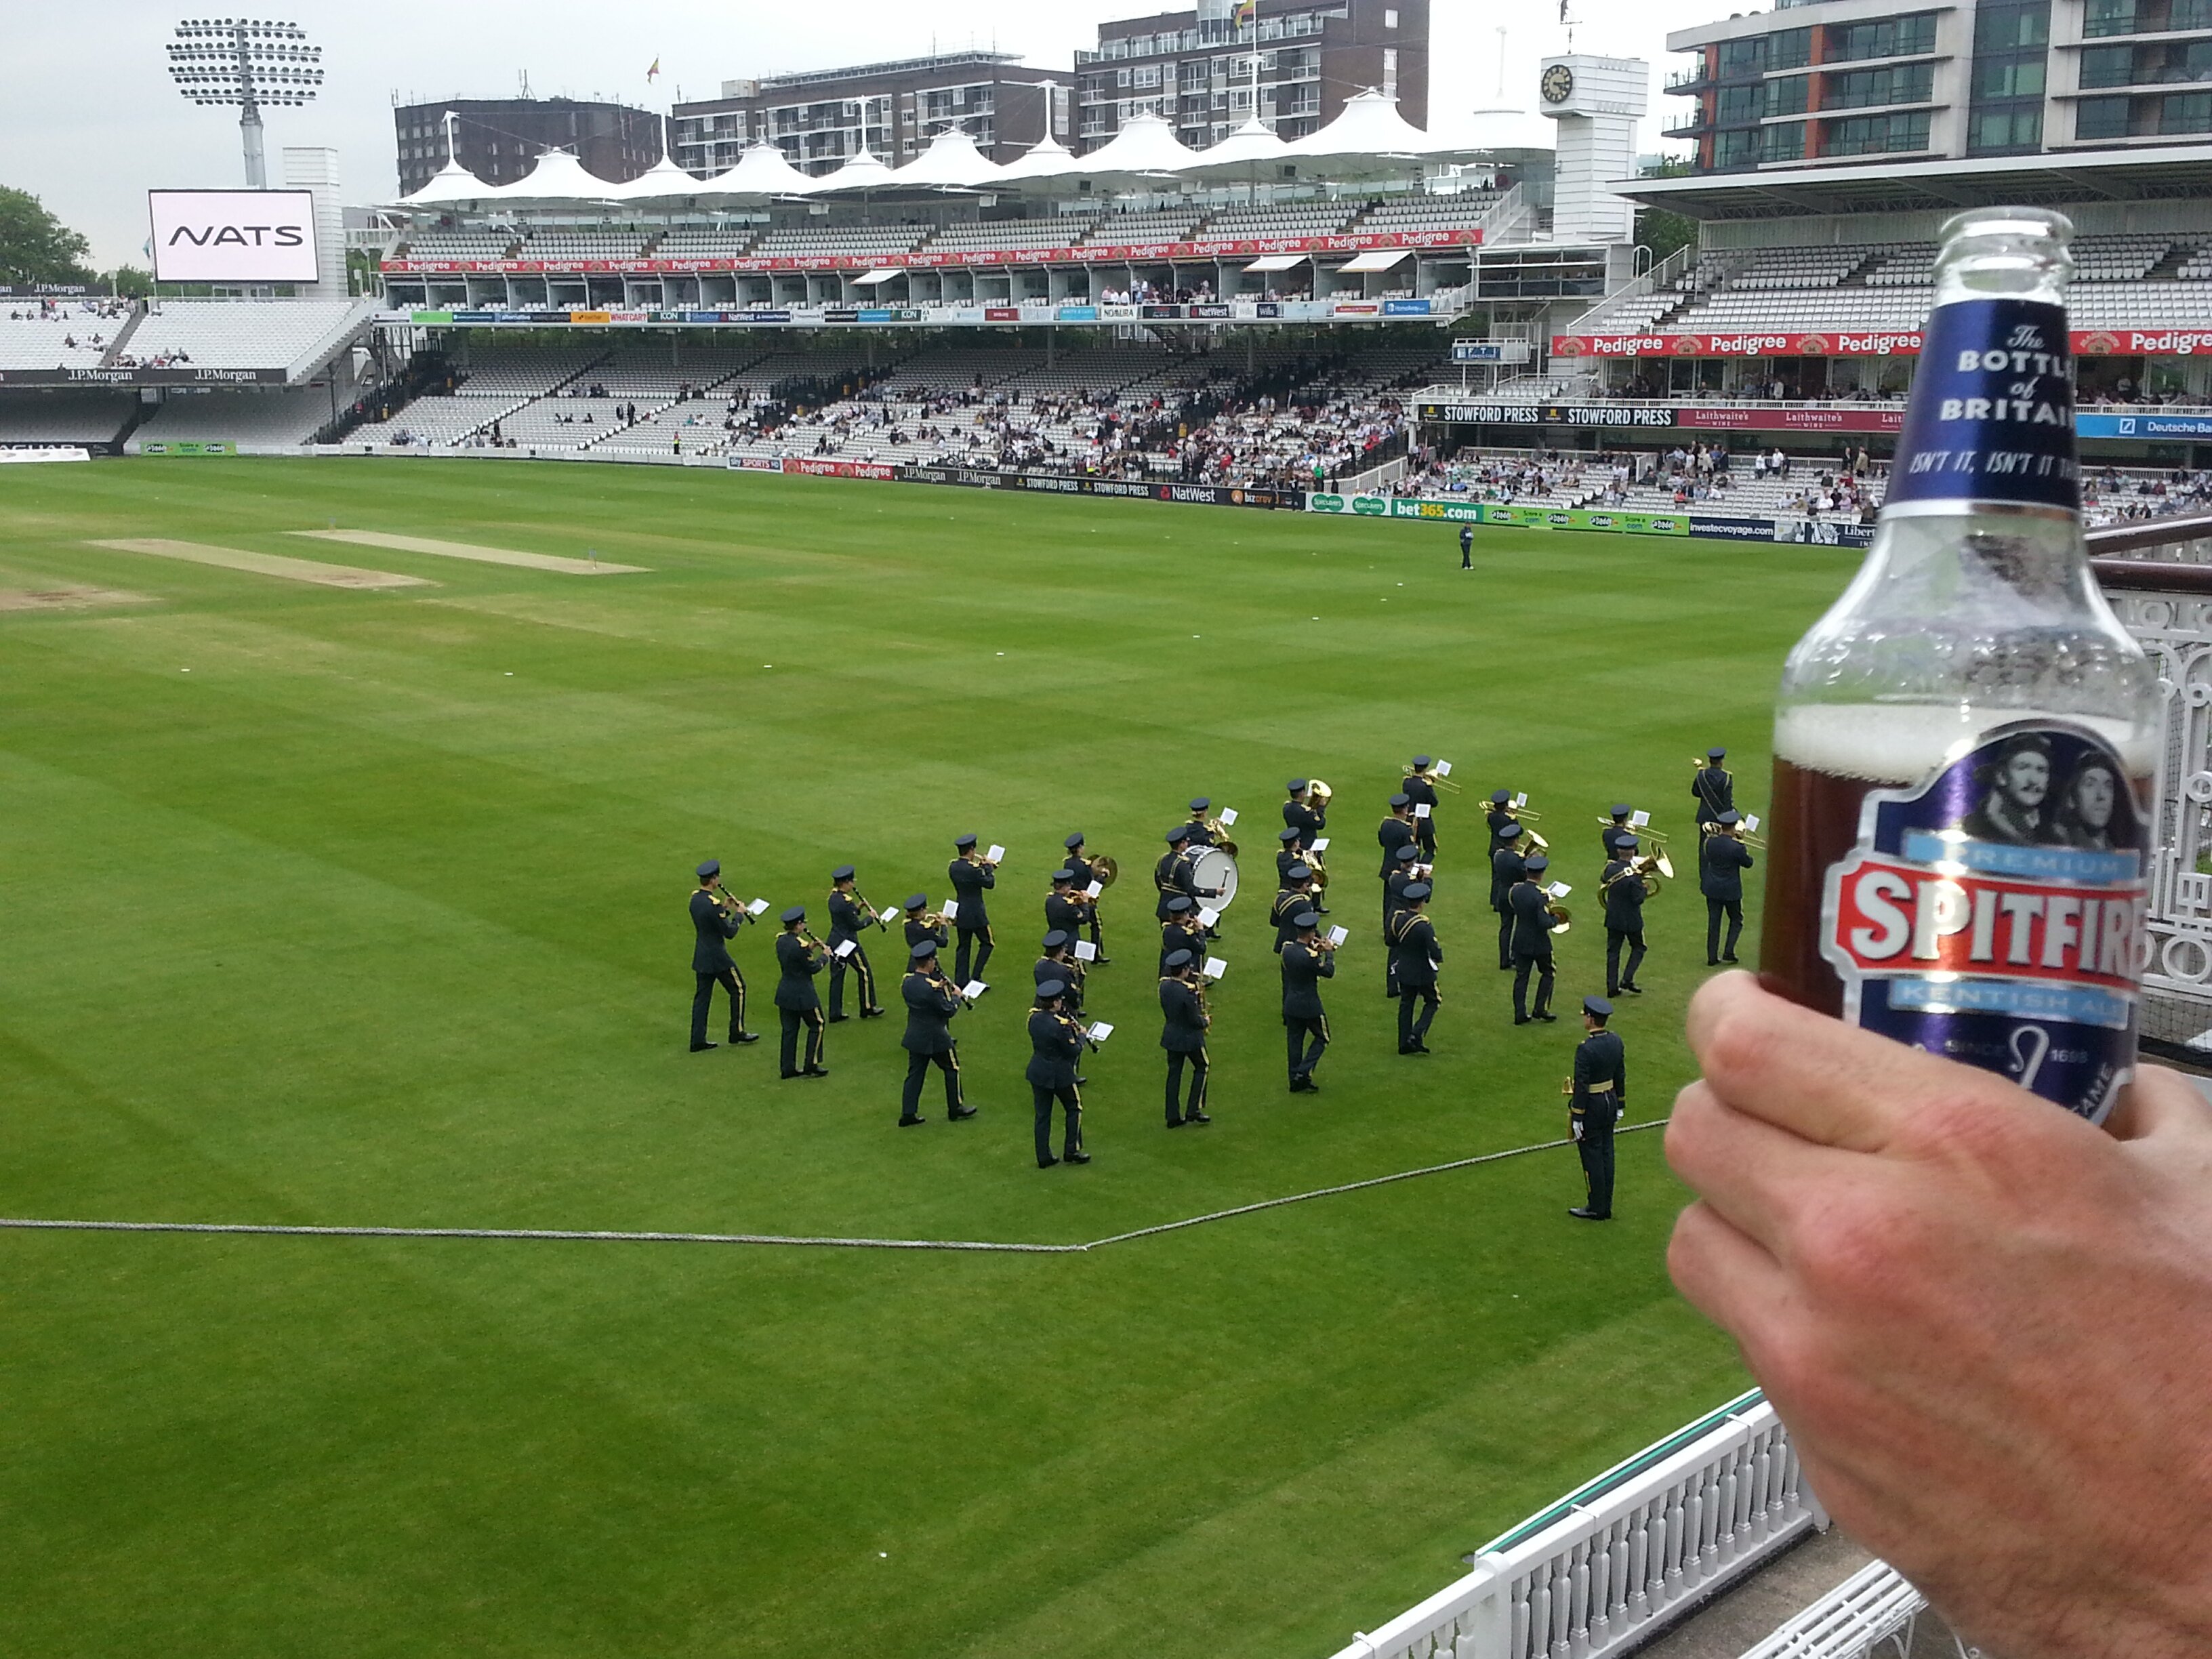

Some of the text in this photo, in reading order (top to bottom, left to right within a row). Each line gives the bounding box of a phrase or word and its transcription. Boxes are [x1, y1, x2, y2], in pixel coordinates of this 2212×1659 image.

[168, 226, 303, 247] NATS
[1328, 235, 1372, 250] Pedigree
[1401, 232, 1450, 247] Pedigree
[1131, 245, 1168, 258] Pedigree
[1193, 241, 1233, 255] Pedigree
[1259, 239, 1300, 253] Pedigree
[962, 253, 996, 264] Pedigree
[1016, 251, 1050, 262] Pedigree
[1072, 248, 1108, 260] Pedigree
[609, 261, 649, 271] Pedigree
[672, 260, 711, 271] Pedigree
[734, 259, 771, 270] Pedigree
[794, 258, 830, 269] Pedigree
[852, 256, 887, 268] Pedigree
[908, 255, 942, 266] Pedigree
[408, 262, 450, 272] Pedigree
[476, 262, 518, 272] Pedigree
[544, 262, 583, 272] Pedigree
[35, 284, 85, 295] J.P.Morgan
[660, 312, 678, 320] ICON
[728, 312, 755, 321] NatWest
[901, 310, 917, 319] ICON
[1104, 308, 1134, 318] NOMURA
[1198, 306, 1228, 316] NatWest
[2007, 325, 2045, 349] The
[2130, 332, 2212, 354] Pedigre
[1593, 337, 1663, 356] Pedigree
[1711, 335, 1786, 355] Pedigree
[1838, 335, 1921, 354] Pedigree
[68, 371, 133, 384] J.P.Morgan
[194, 369, 256, 384] J.P.Morgan
[2009, 376, 2040, 399] of
[1444, 406, 1538, 423] STOWFORD PRESS
[1568, 408, 1672, 426] STOWFORD PRESS
[1696, 411, 1748, 420] Laithwaite's
[1786, 412, 1843, 422] Laithwaite's
[2148, 422, 2196, 432] Deutsche
[743, 459, 770, 468] SPORTS
[800, 462, 835, 474] Pedigree
[1909, 451, 1952, 474] ISN'T
[1986, 452, 2034, 474] ISN'T
[855, 465, 890, 479] Pedigree
[903, 467, 946, 482] J.P.Morgan
[957, 470, 1002, 485] J.P.Morgan
[1027, 478, 1078, 491] STOWFORD PRESS
[1094, 483, 1149, 496] STOWFORD PRESS
[1172, 486, 1215, 502] NatWest
[1244, 492, 1279, 504] bizcro
[1314, 498, 1342, 507] Specsavers
[1355, 501, 1383, 510] Specsavers
[1397, 501, 1477, 520] bet365.com
[1690, 523, 1774, 535] investecvoyage.com
[1902, 985, 2068, 1009] KENTISH
